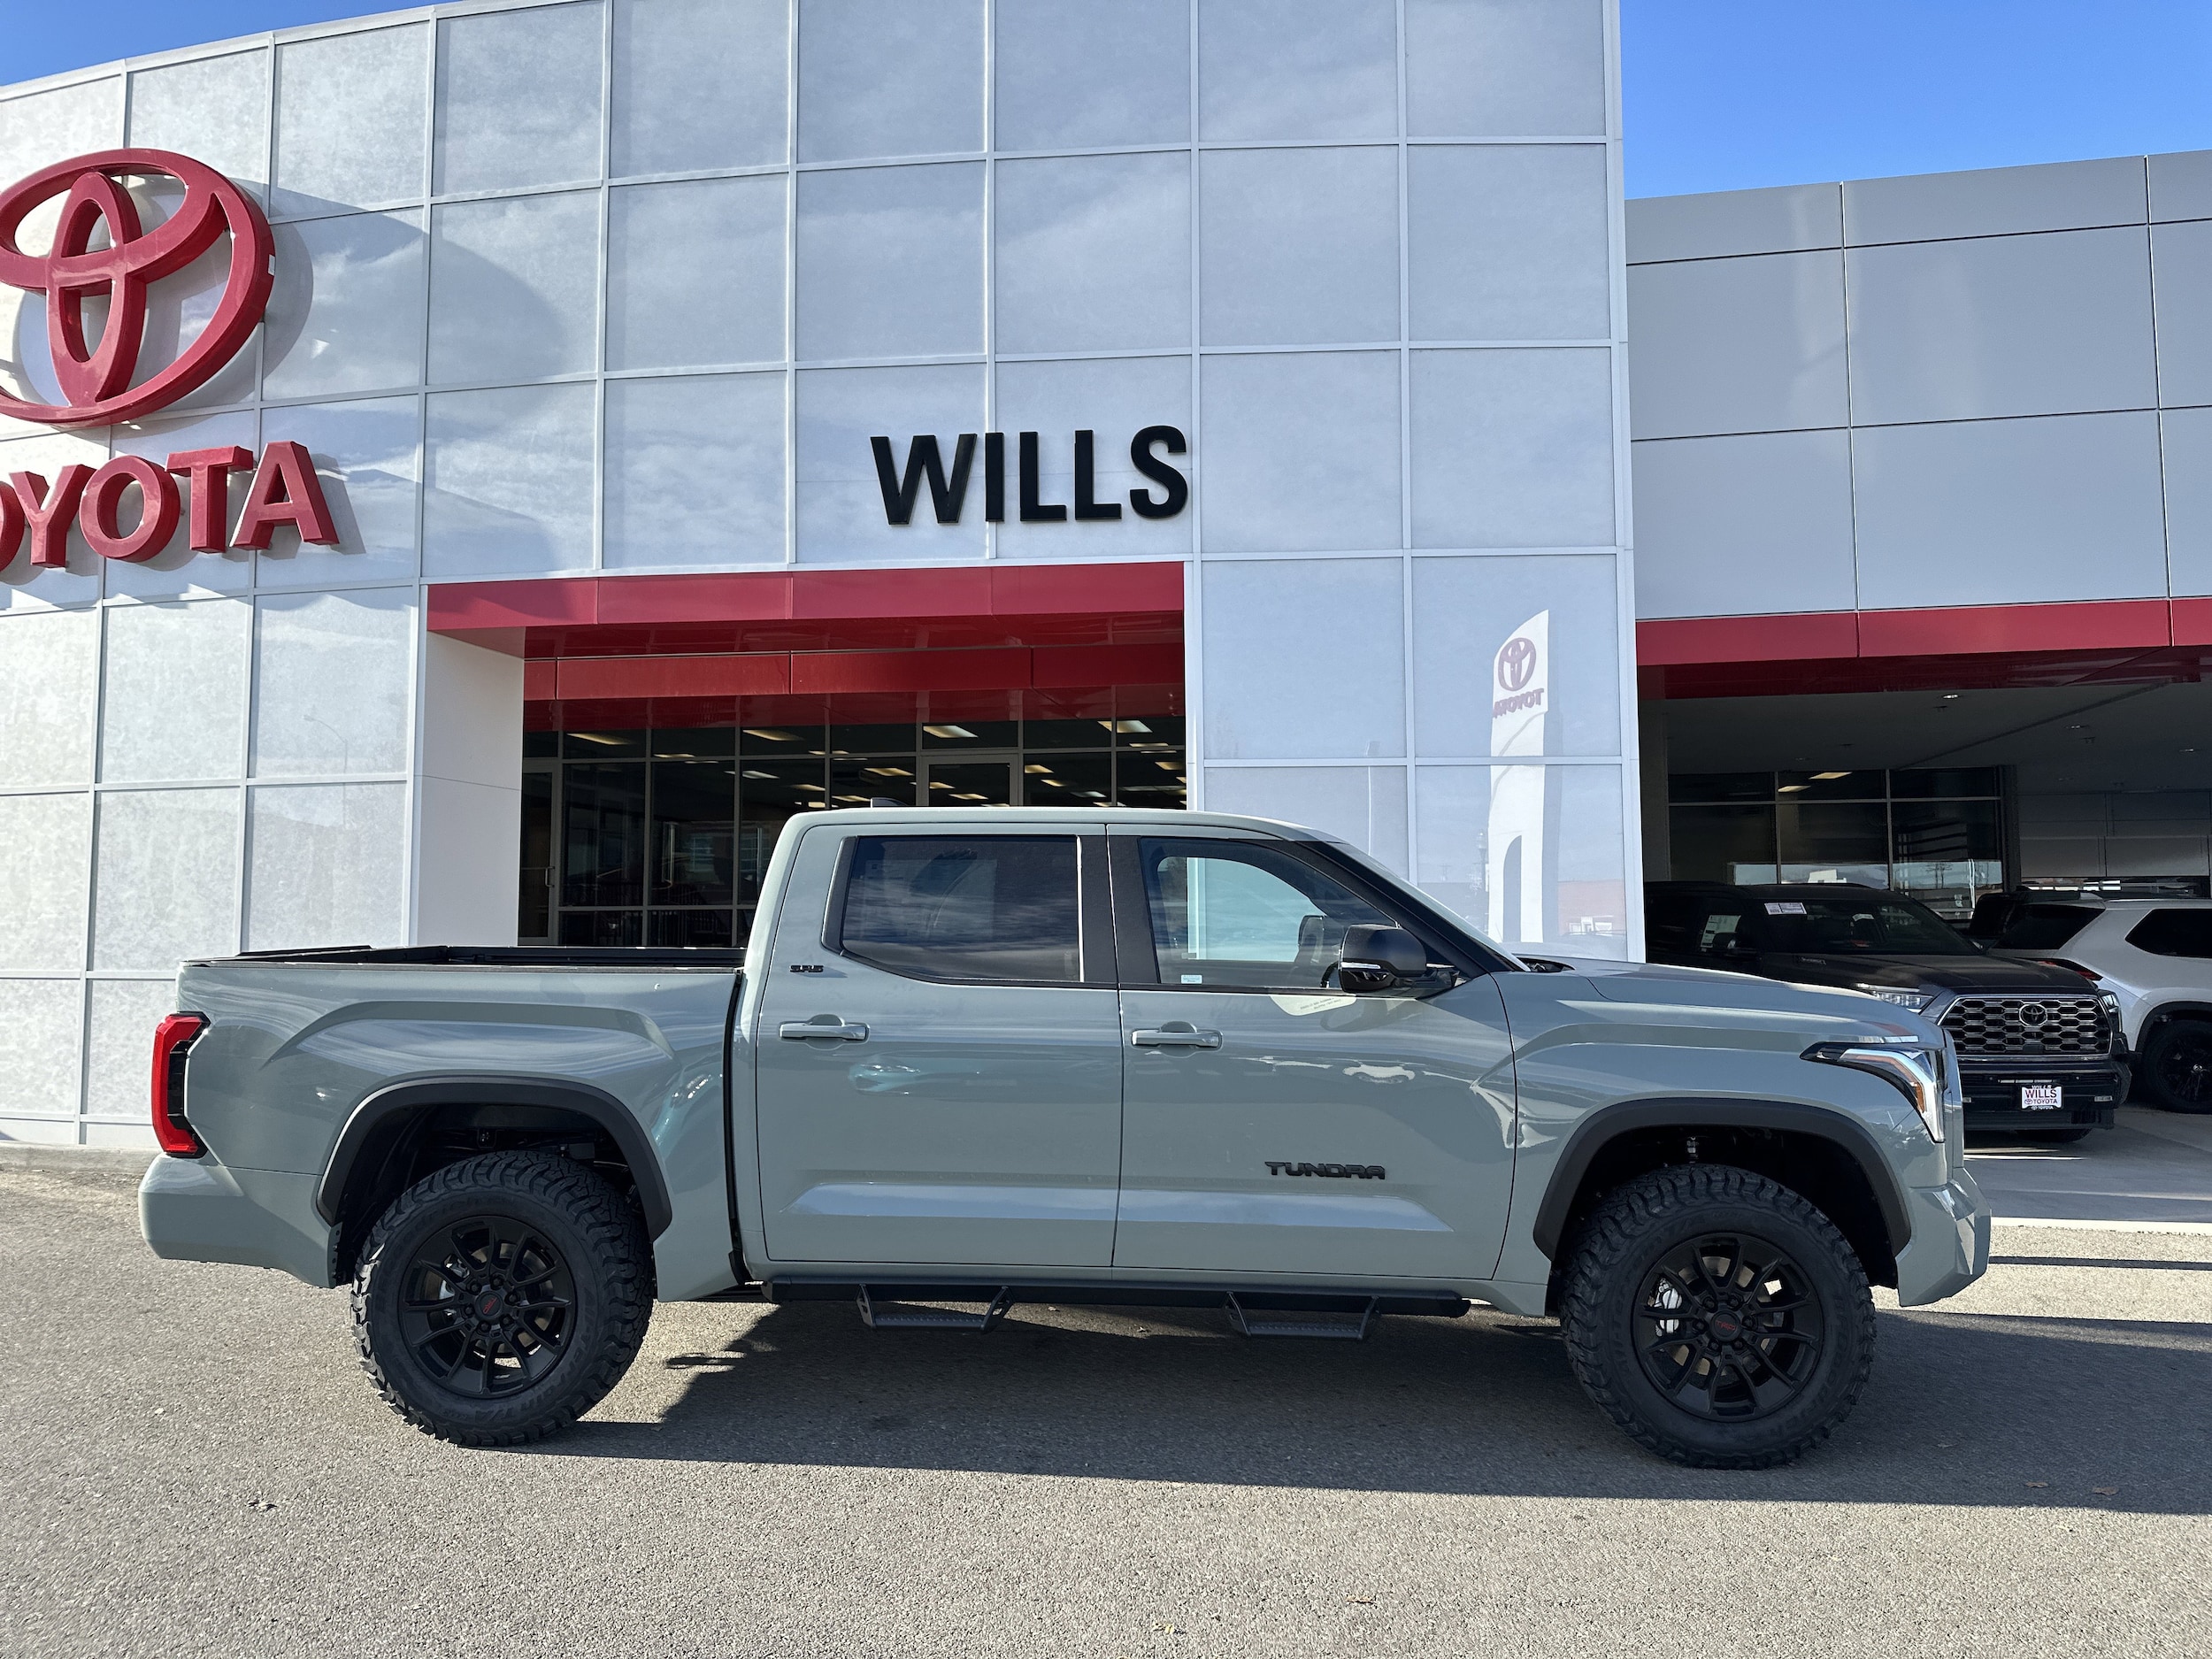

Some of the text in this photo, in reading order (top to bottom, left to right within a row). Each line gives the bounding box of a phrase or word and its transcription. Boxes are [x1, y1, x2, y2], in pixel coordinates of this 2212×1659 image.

[870, 425, 1188, 525] WILLS
[0, 441, 340, 571] YOTA
[790, 964, 824, 973] SR5
[2025, 1089, 2057, 1098] WILLS
[1264, 1161, 1386, 1180] TUNDRA
